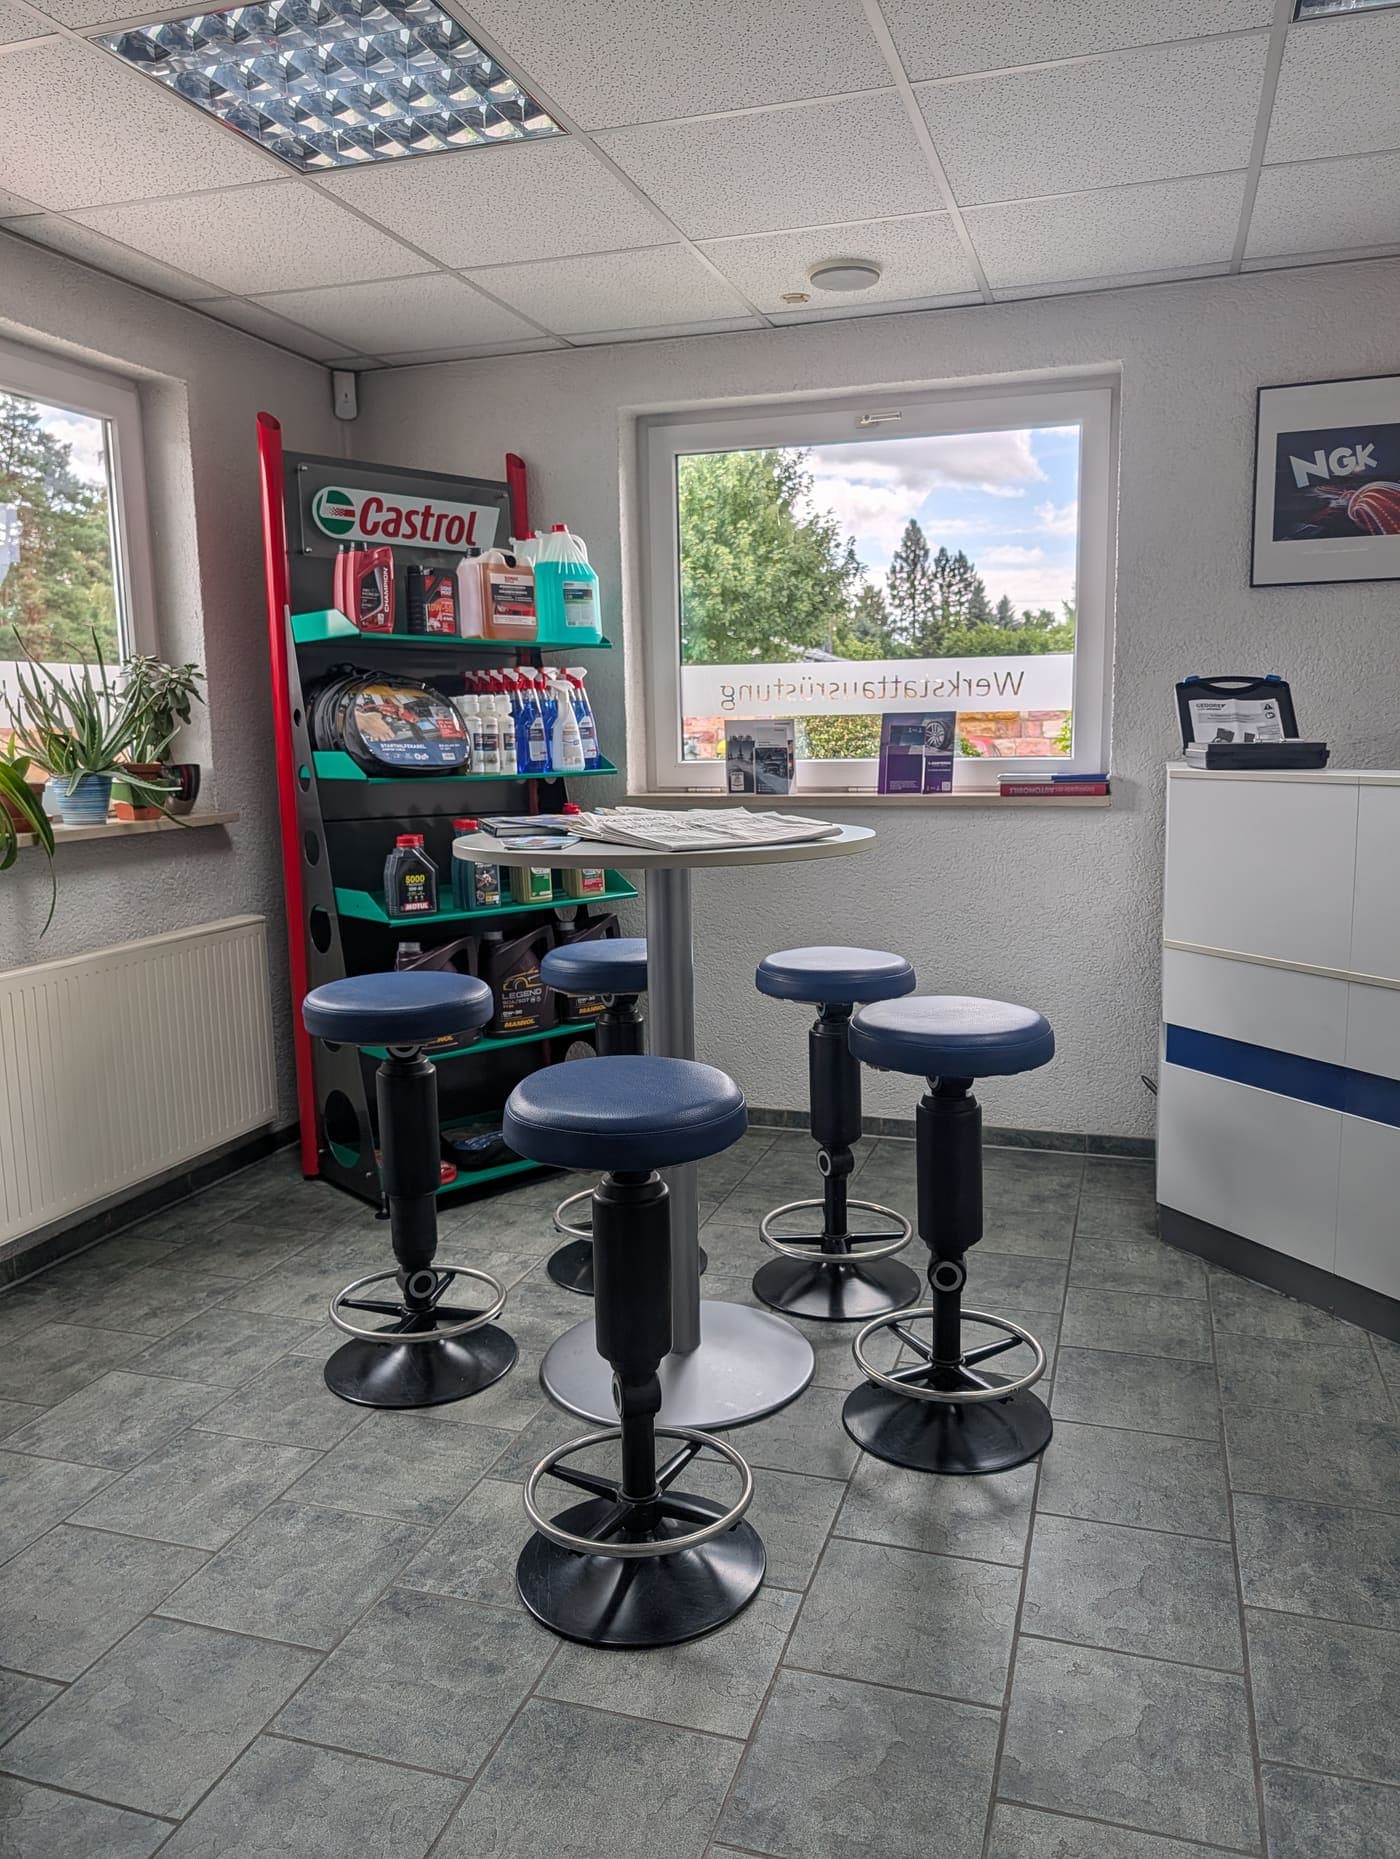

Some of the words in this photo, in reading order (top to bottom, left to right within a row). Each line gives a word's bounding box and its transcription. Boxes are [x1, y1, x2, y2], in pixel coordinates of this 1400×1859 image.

[1289, 443, 1378, 488] NGK
[359, 497, 478, 546] Castrol
[405, 874, 426, 885] 5000
[405, 902, 429, 910] MOTUL
[502, 988, 542, 1000] LEGEND
